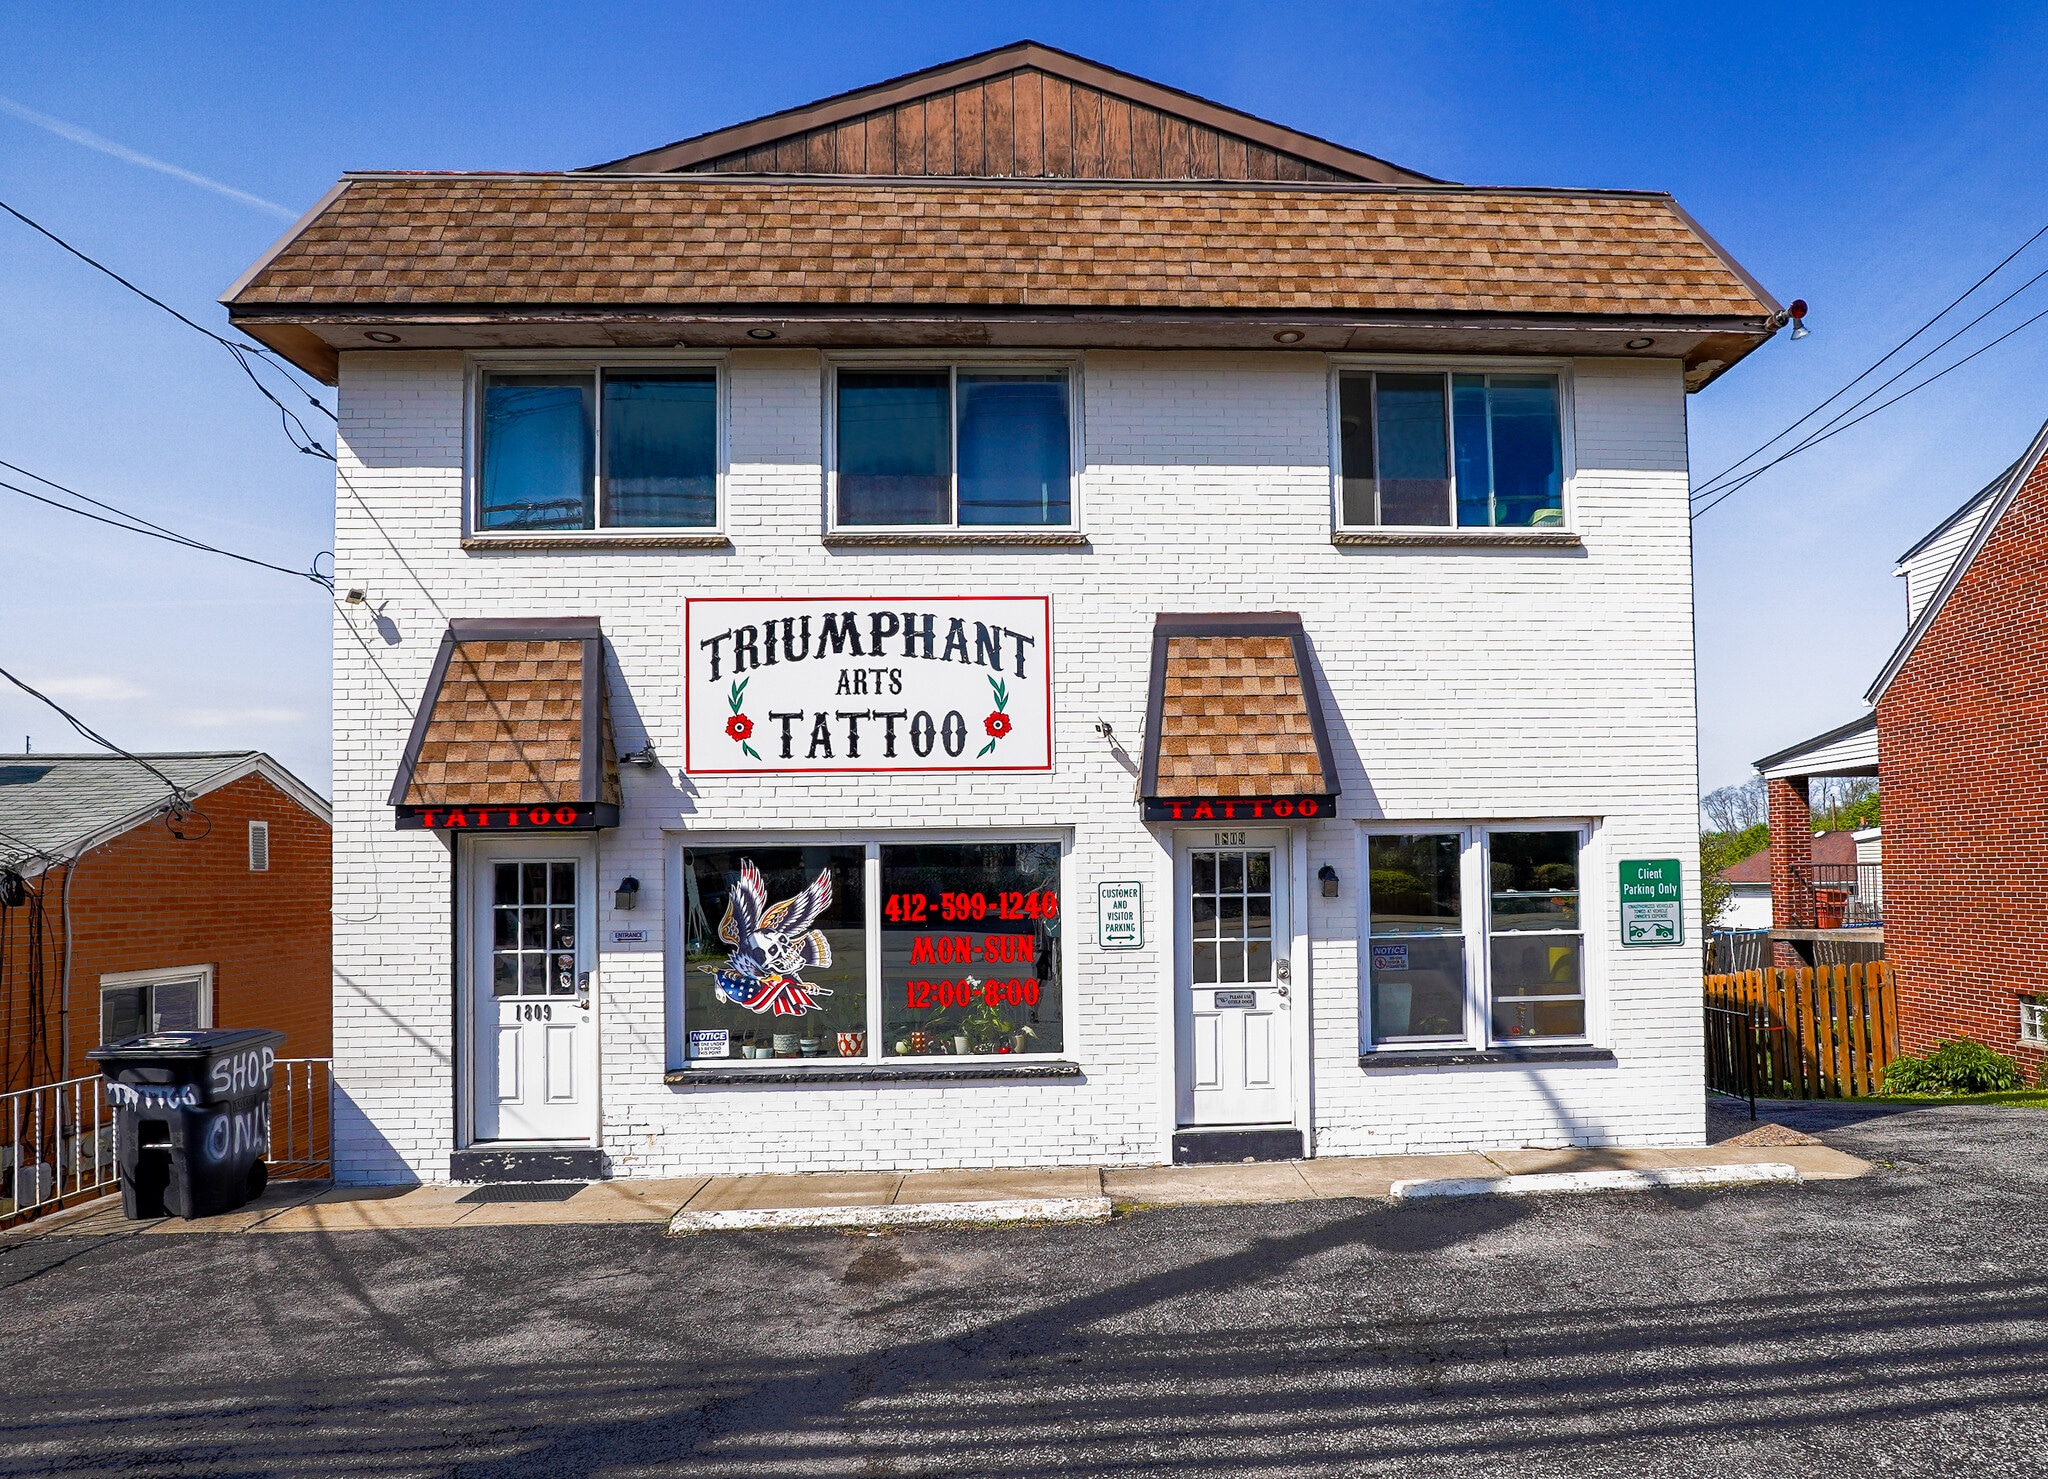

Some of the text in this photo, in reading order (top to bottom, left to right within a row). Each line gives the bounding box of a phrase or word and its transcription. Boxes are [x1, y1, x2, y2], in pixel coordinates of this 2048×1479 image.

[700, 611, 1035, 682] TRIUMPHANT
[835, 667, 902, 696] ARTS
[768, 708, 968, 759] TATTOO
[414, 806, 577, 827] TATTOO
[1162, 799, 1319, 819] TATTOO
[1638, 868, 1662, 879] Client
[1102, 889, 1138, 898] CUSTOMER
[1624, 883, 1677, 897] Parking Only
[885, 891, 1058, 922] 412-599-1240
[1113, 901, 1127, 909] AND
[1107, 912, 1133, 920] VISITOR
[1105, 923, 1135, 932] PARKING
[909, 934, 1035, 965] MON-SUN
[906, 977, 1040, 1009] 12:00-8:00
[515, 1004, 552, 1022] 1809
[692, 1032, 726, 1041] NOTICE
[212, 1046, 274, 1093] SHOP
